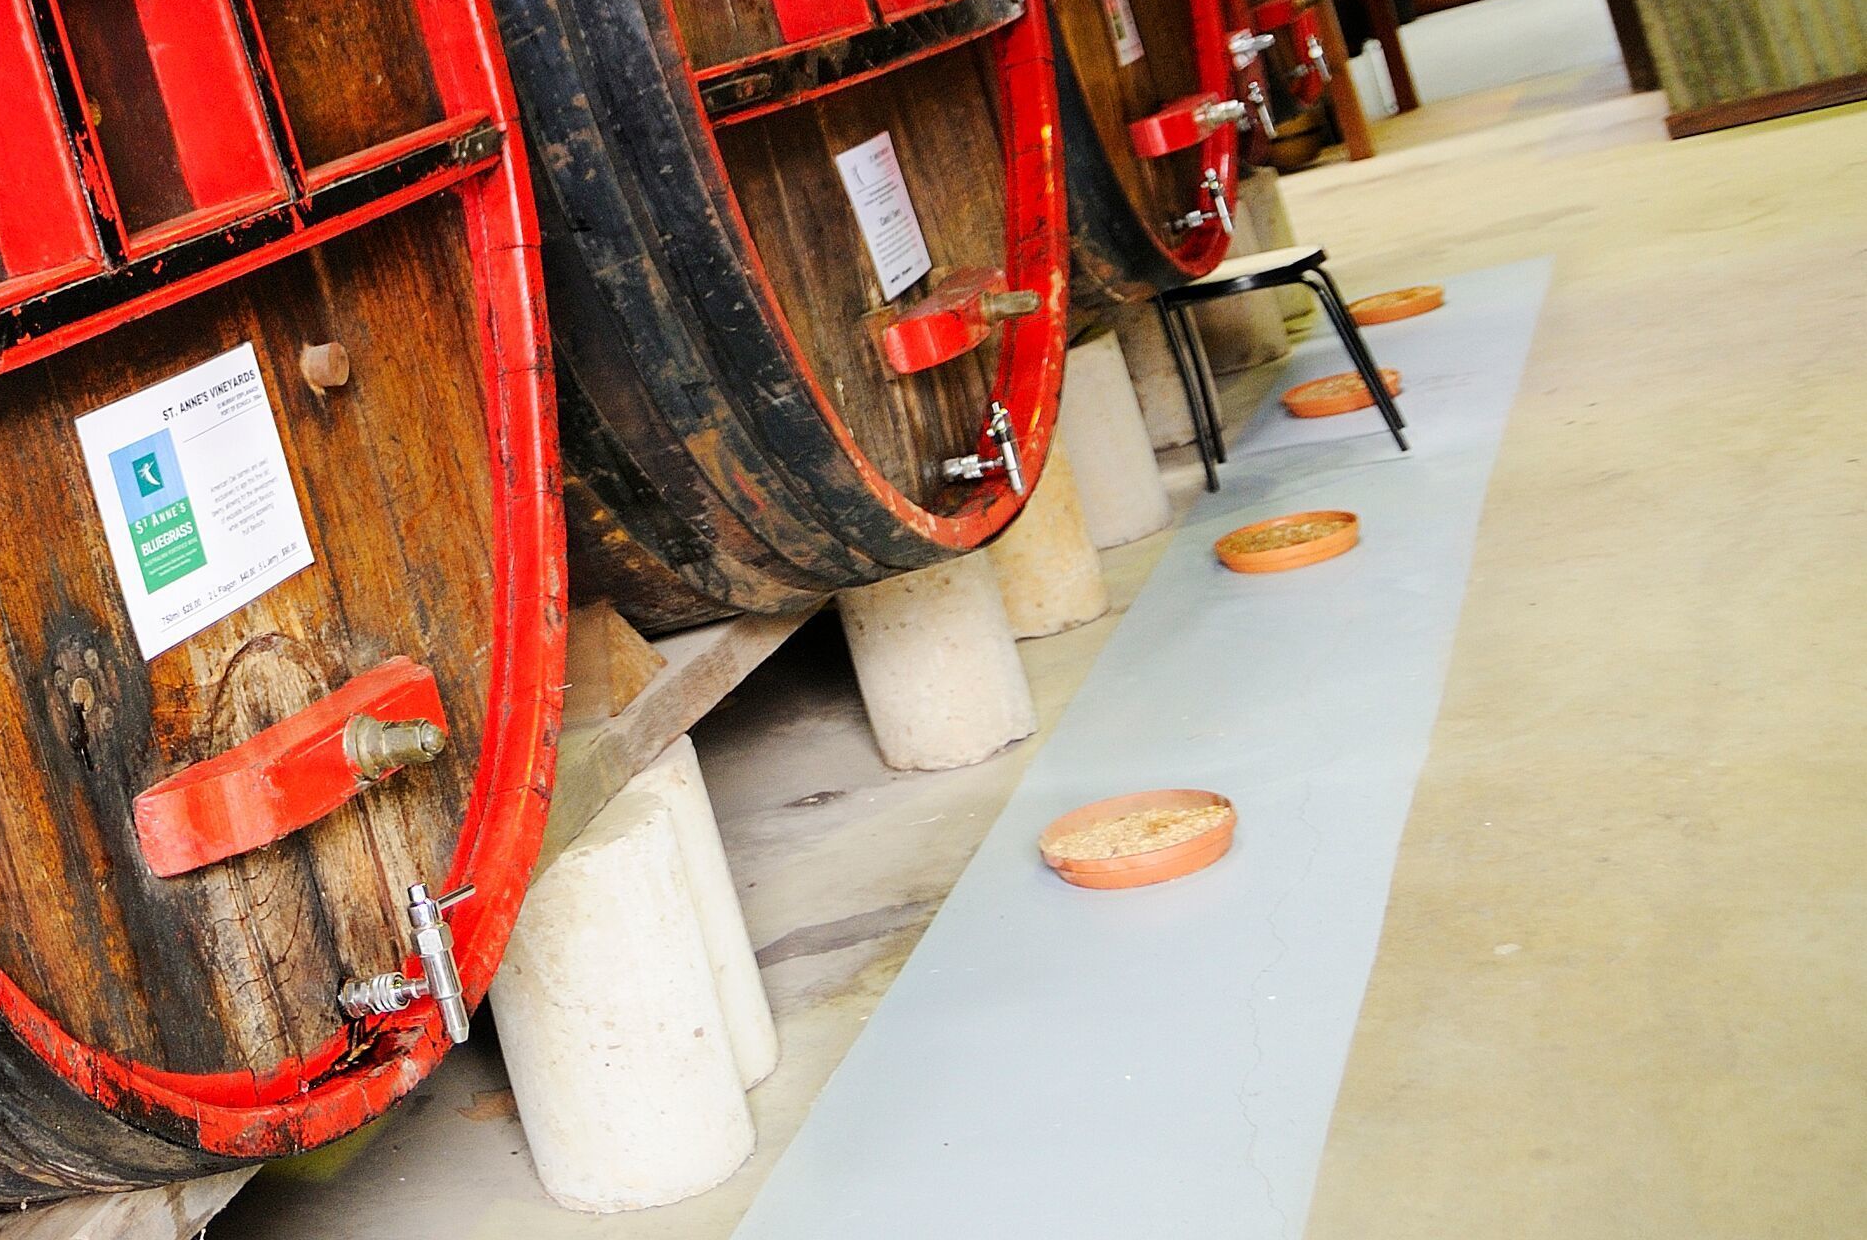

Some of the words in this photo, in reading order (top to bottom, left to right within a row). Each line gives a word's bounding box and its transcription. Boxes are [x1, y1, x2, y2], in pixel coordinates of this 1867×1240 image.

[163, 407, 178, 421] ST.
[179, 390, 209, 413] ANNE'S
[209, 369, 256, 398] VINEYARDS
[151, 502, 187, 527] ANNE'S
[140, 521, 194, 557] BLUEGRASS
